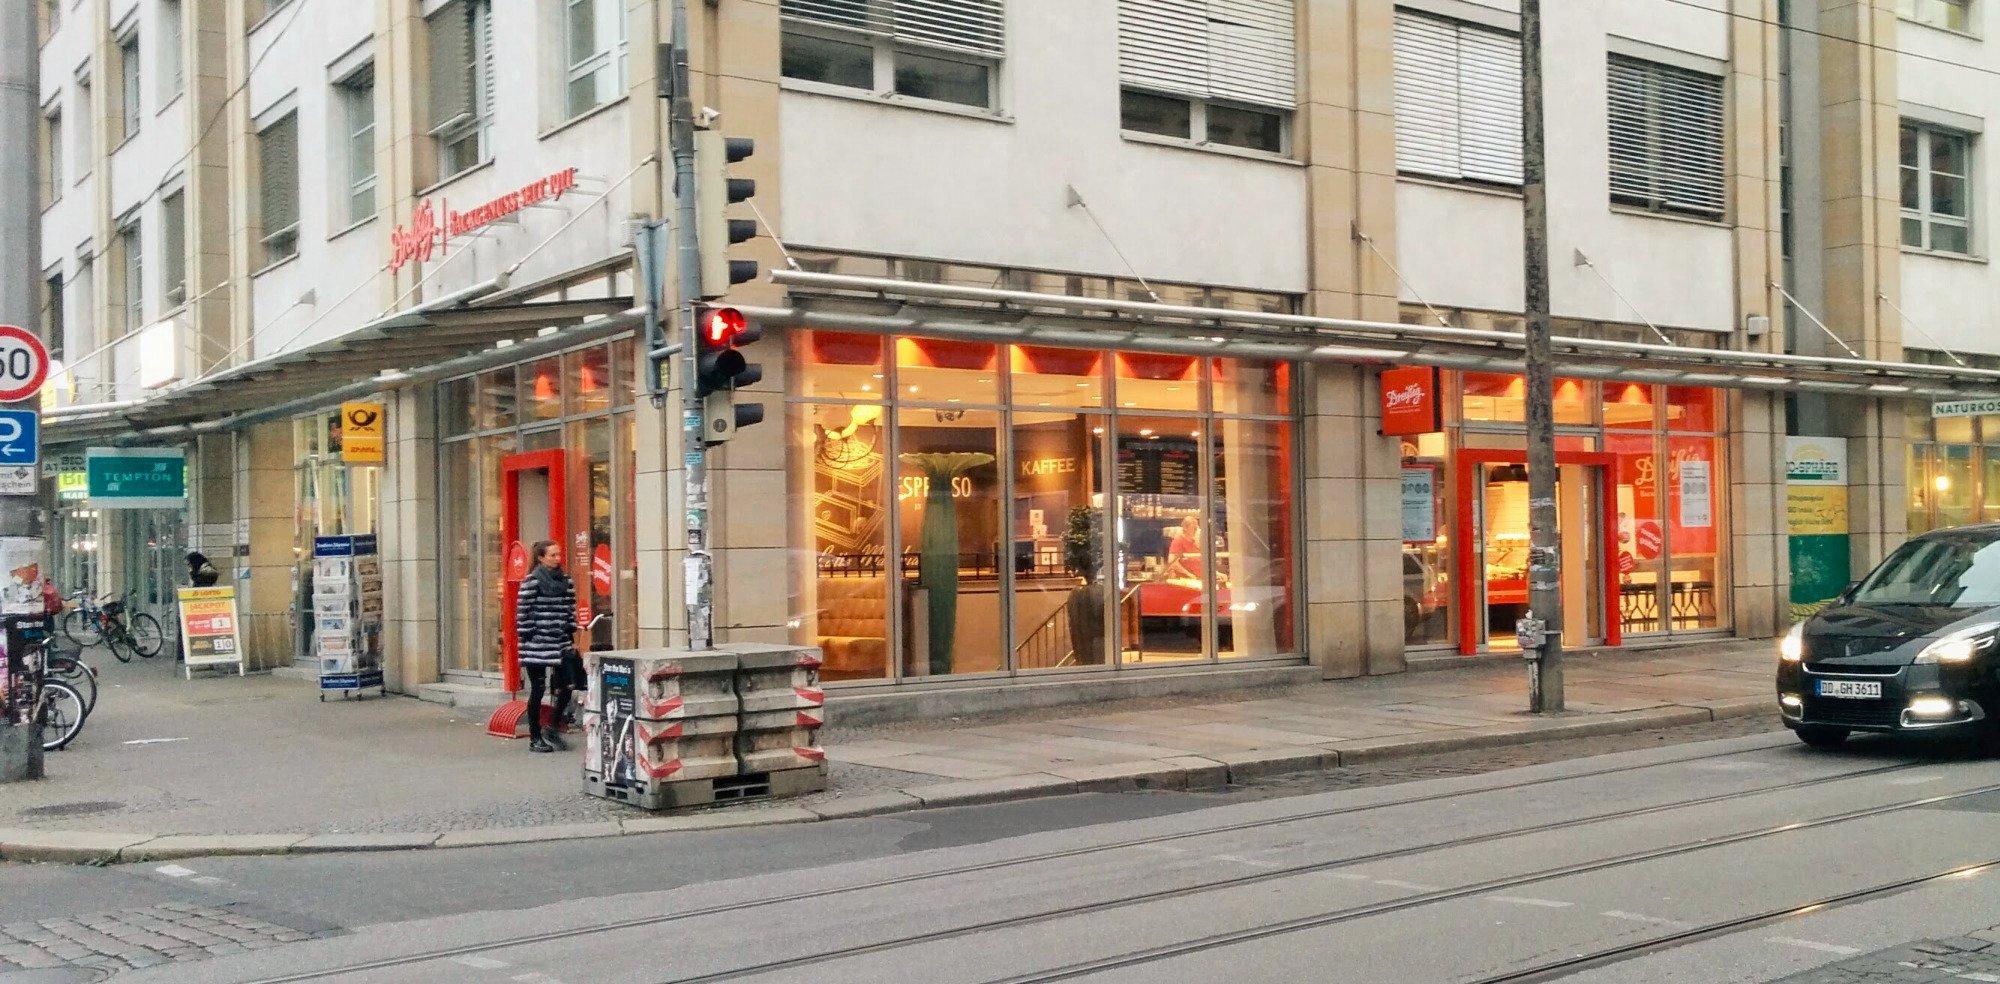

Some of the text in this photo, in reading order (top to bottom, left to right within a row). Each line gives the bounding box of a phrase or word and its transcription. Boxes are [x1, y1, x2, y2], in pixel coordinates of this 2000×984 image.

[1021, 458, 1075, 476] KAFFEE
[103, 472, 172, 482] TEMPTON
[1855, 684, 1880, 696] 3611
